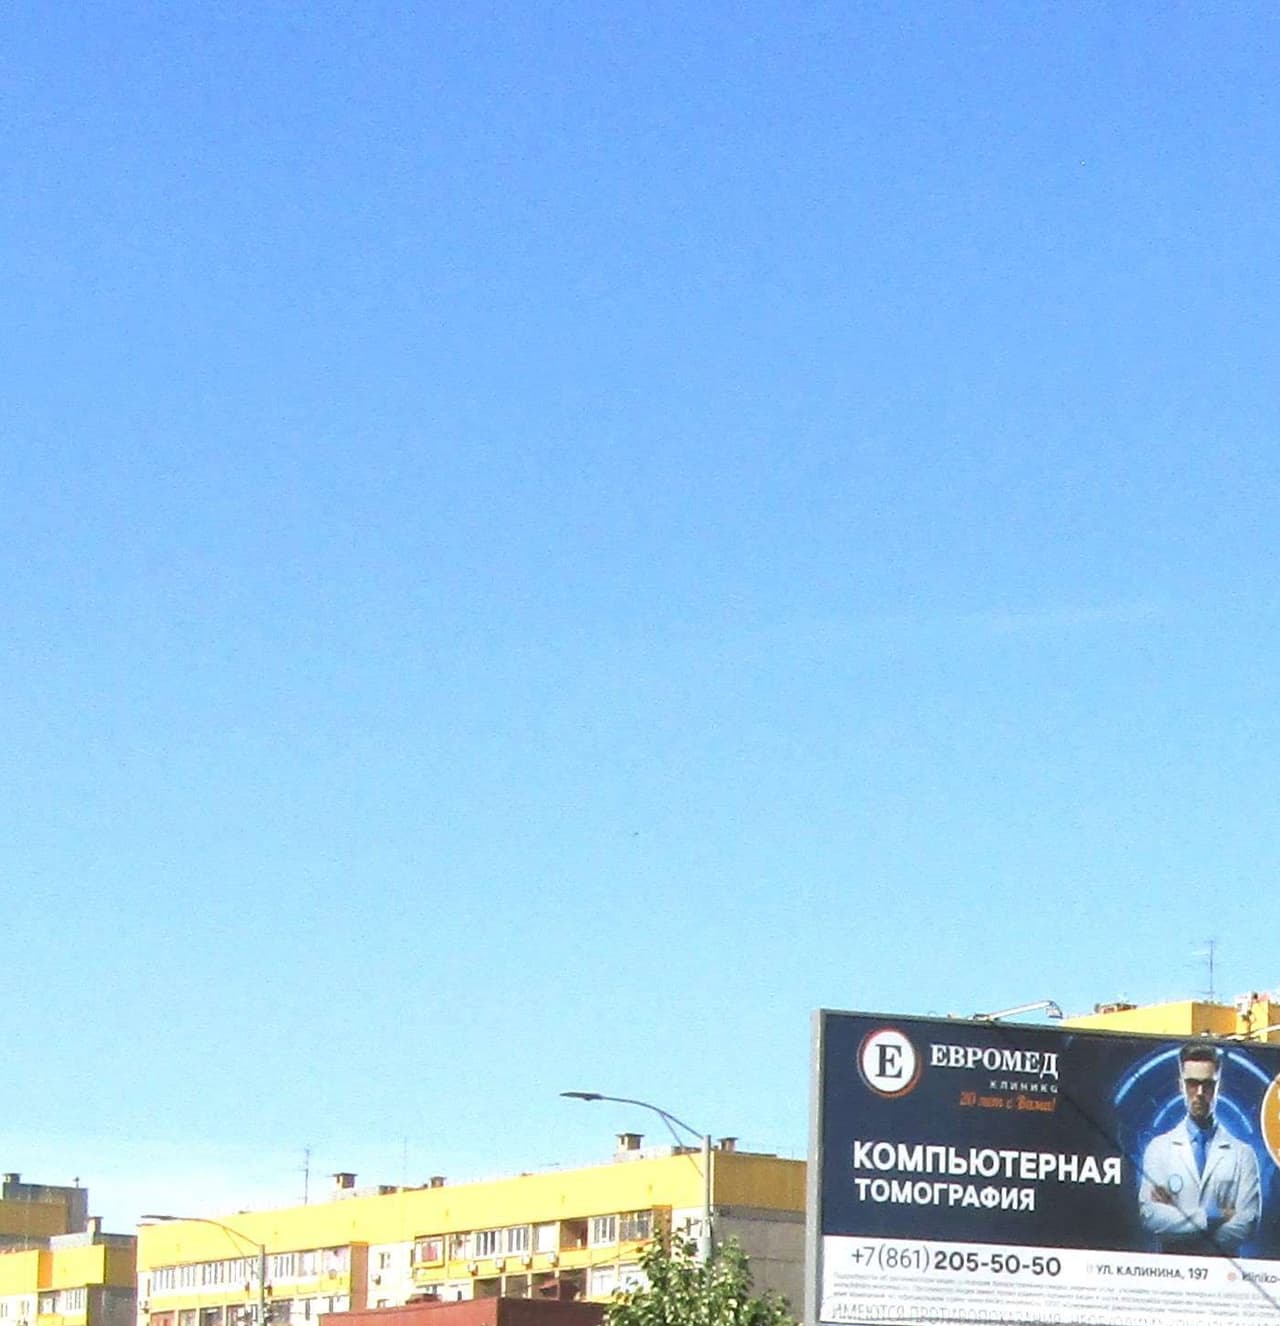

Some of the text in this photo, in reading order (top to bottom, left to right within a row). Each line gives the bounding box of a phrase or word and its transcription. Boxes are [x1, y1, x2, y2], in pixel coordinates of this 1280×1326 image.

[930, 1044, 1059, 1079] ЕВРОМЕД
[853, 1140, 1121, 1185] КОМПЬЮТЕРНАЯ
[854, 1177, 1036, 1211] ТОМОГРАФИЯ
[934, 1250, 1061, 1277] 205-50-50
[1115, 1266, 1185, 1280] КАЛИНИНА,
[1187, 1267, 1209, 1281] 197
